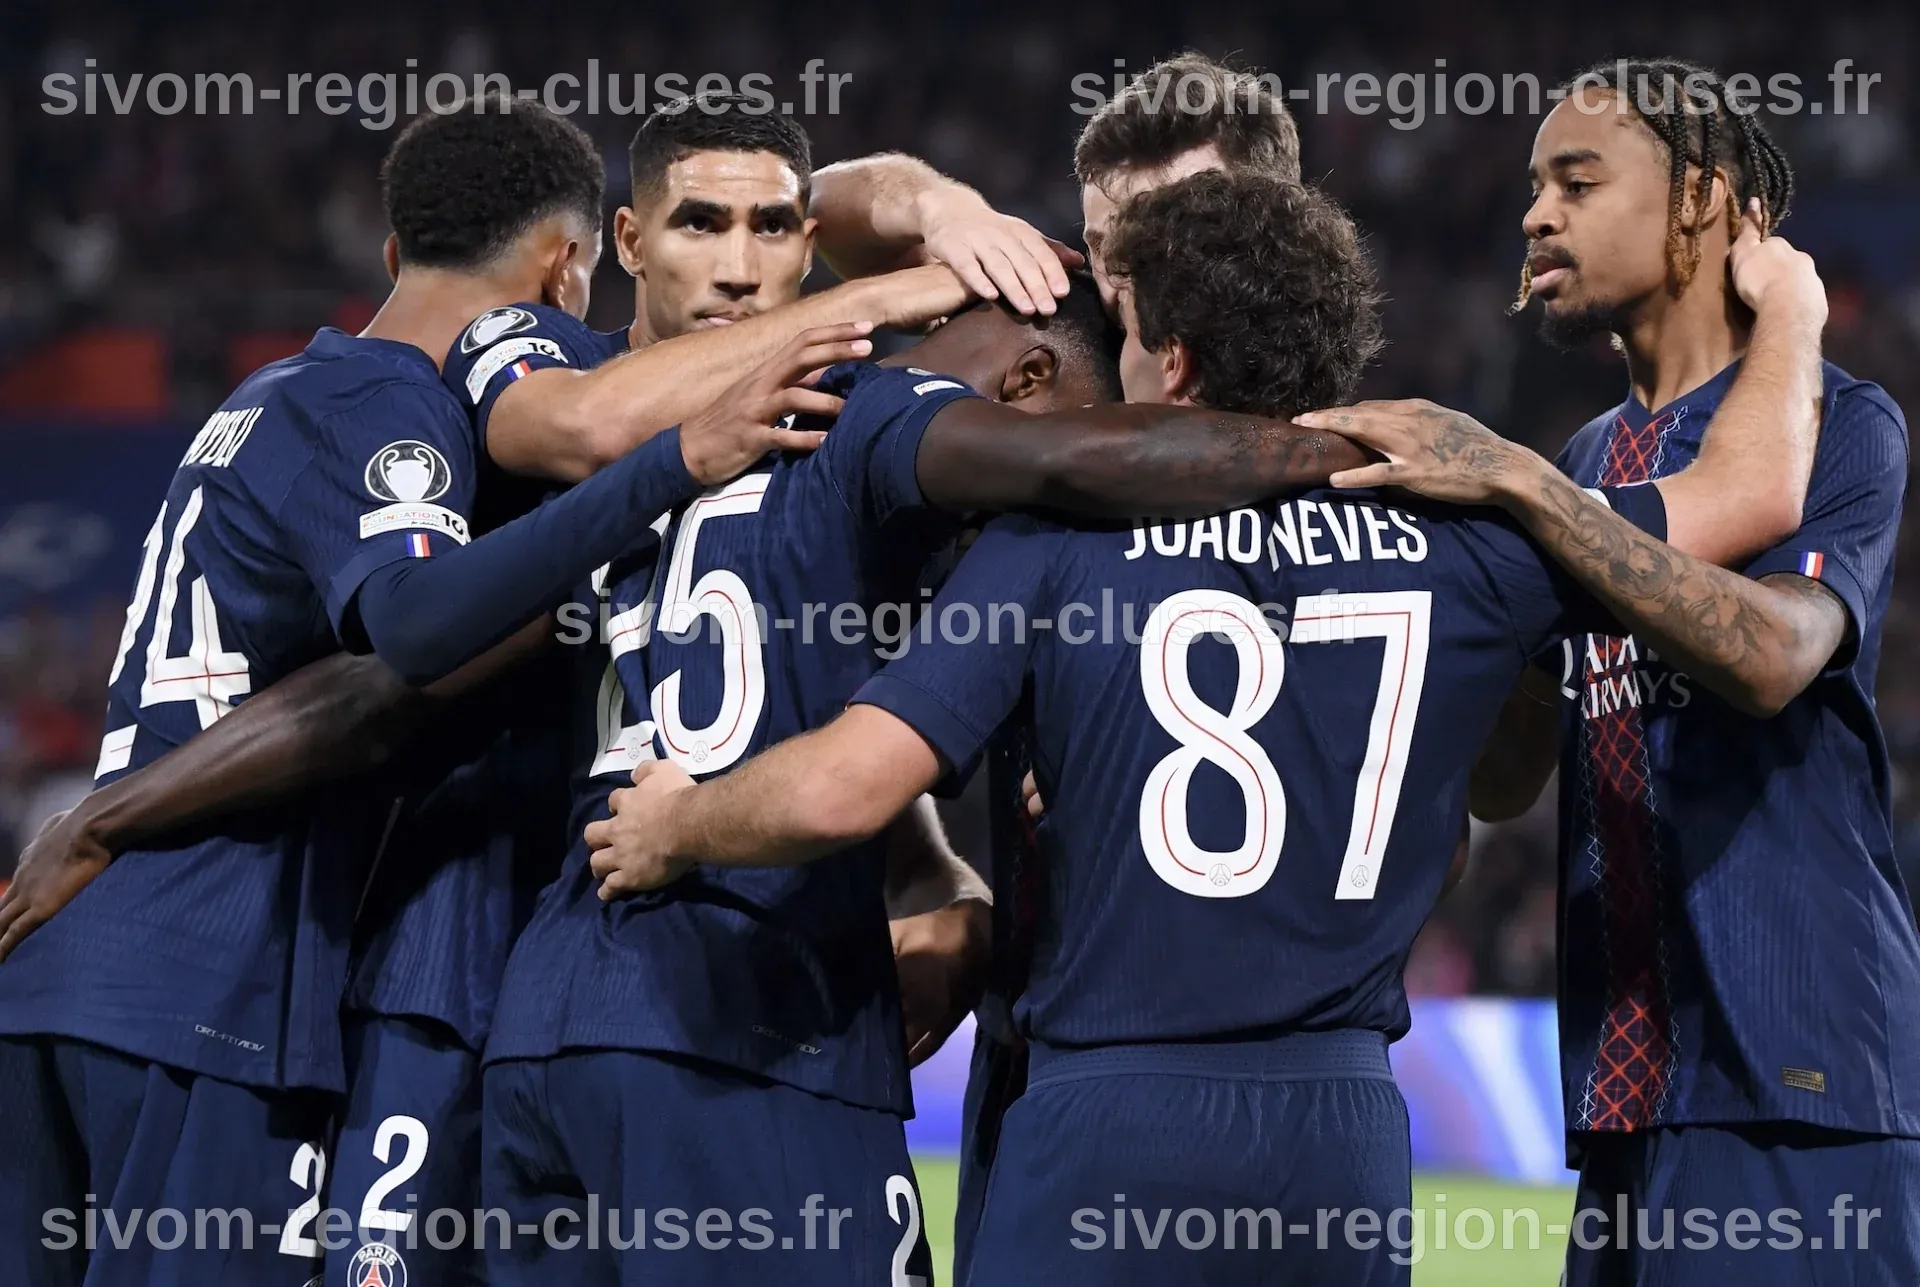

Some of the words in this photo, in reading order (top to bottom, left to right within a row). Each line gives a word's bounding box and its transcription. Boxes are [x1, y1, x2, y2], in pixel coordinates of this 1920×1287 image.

[1267, 499, 1428, 572] NEVES
[1139, 588, 1433, 901] 87
[278, 1141, 326, 1258] 2
[359, 1114, 430, 1232] 2
[357, 1246, 398, 1266] PARIS
